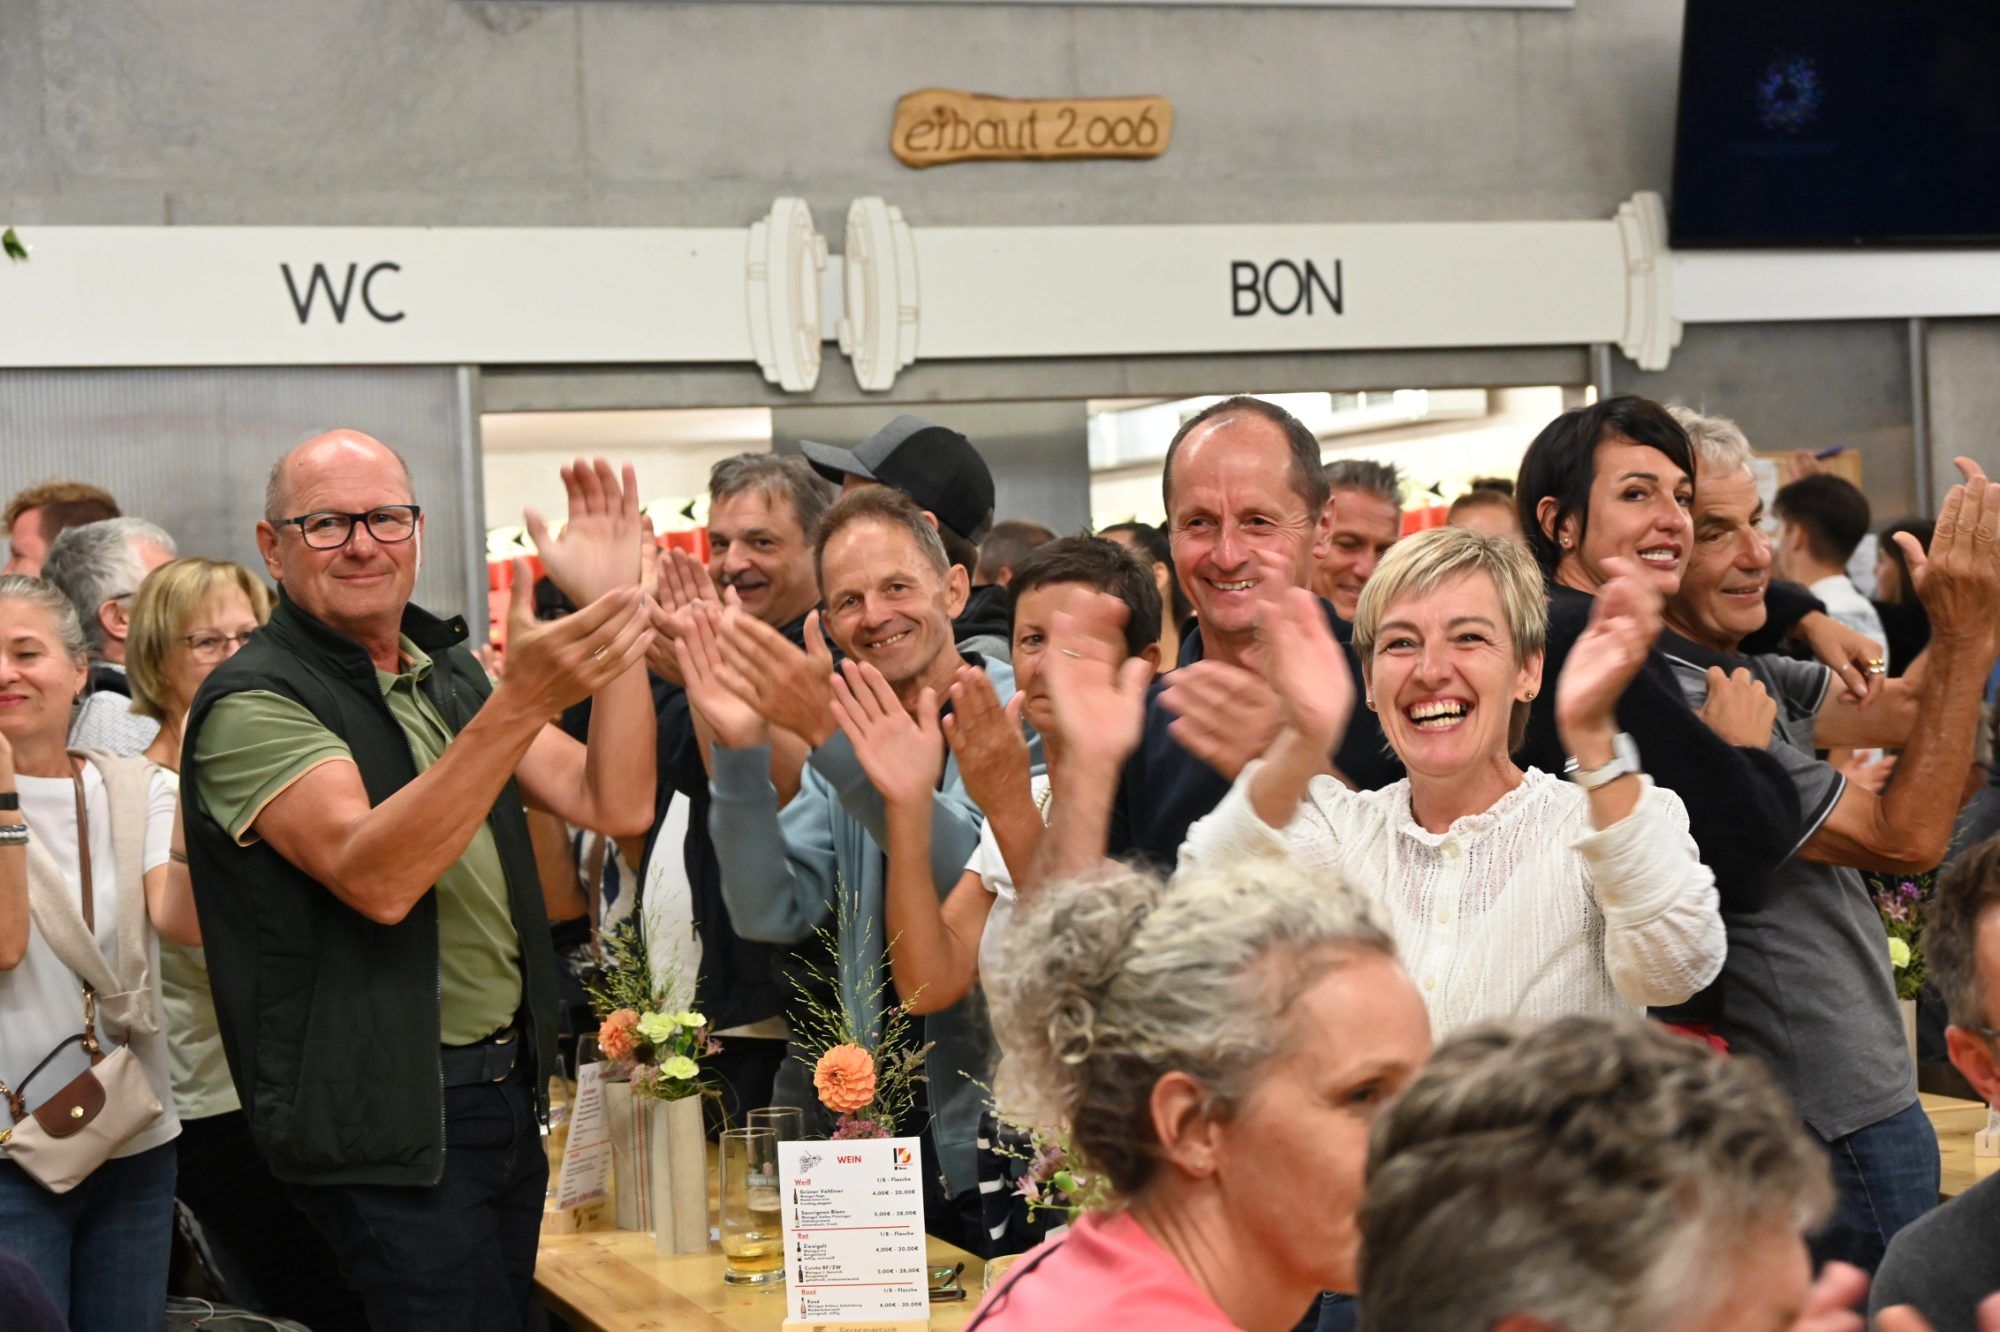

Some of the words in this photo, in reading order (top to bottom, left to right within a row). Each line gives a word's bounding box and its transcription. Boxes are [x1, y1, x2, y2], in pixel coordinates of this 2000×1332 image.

[904, 107, 1038, 151] erbaut
[1055, 105, 1158, 148] 2006
[280, 261, 404, 323] WC
[1231, 258, 1342, 316] BON
[794, 1178, 811, 1186] Weiß
[837, 1155, 862, 1164] WEIN
